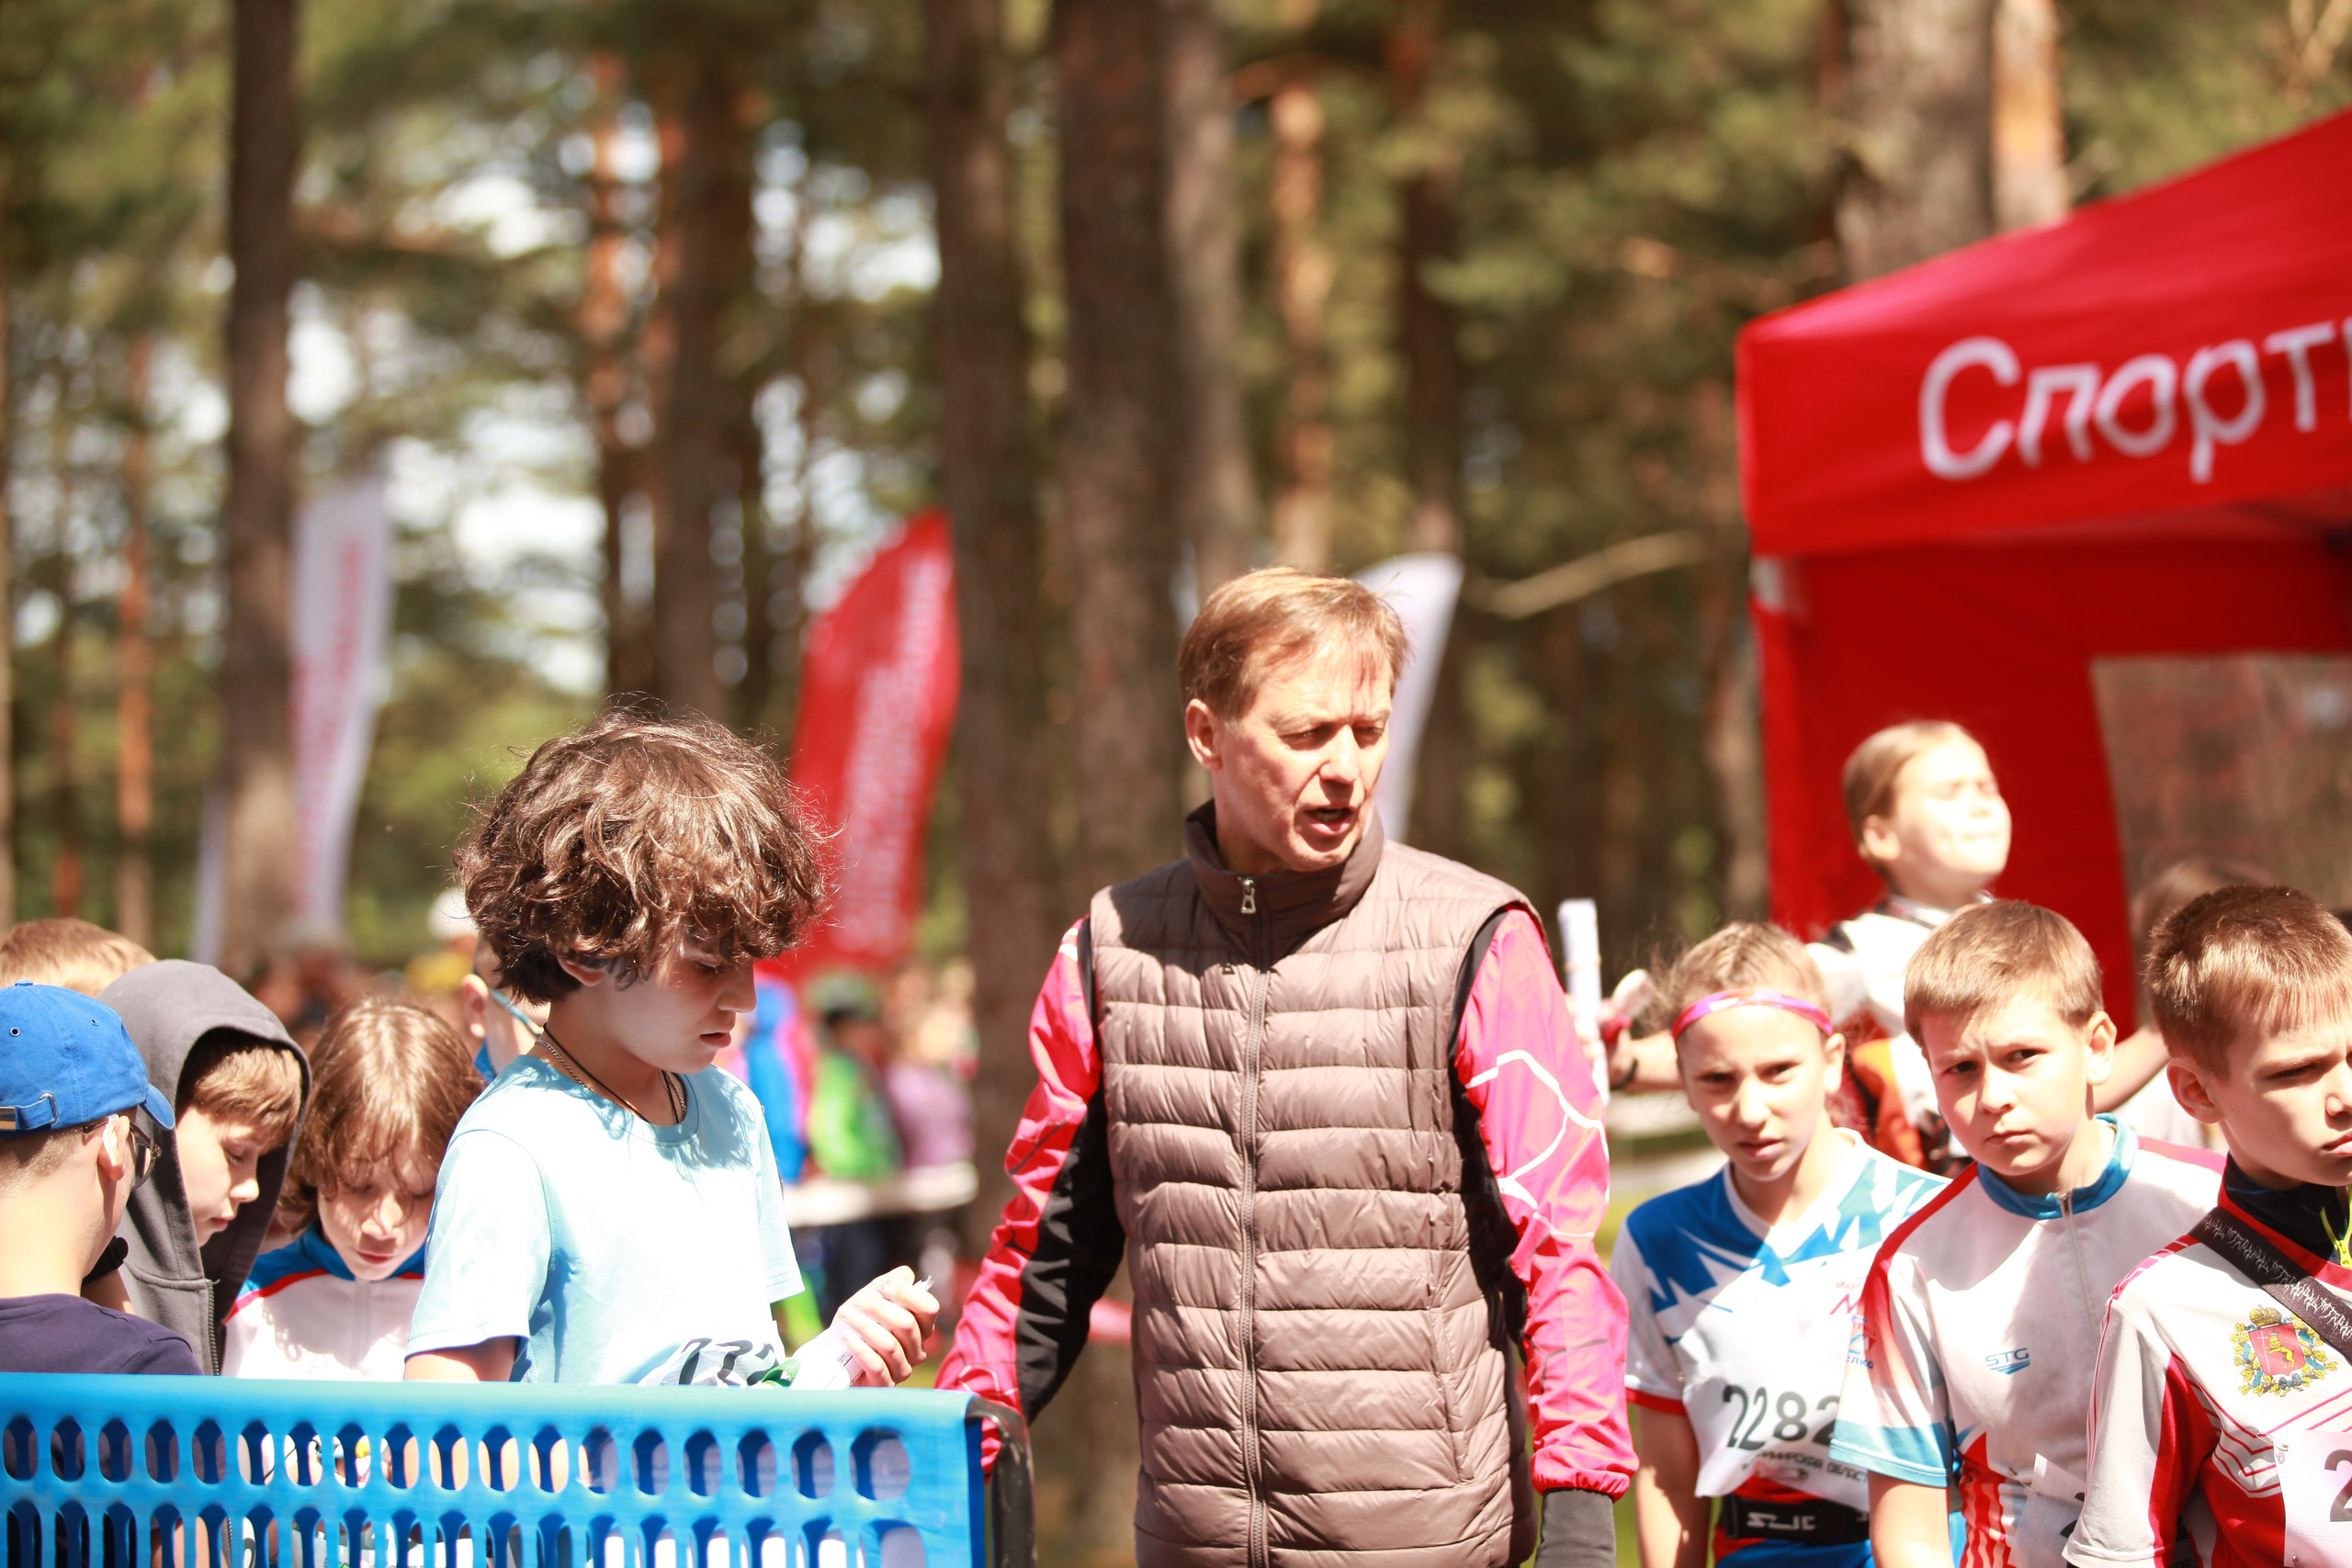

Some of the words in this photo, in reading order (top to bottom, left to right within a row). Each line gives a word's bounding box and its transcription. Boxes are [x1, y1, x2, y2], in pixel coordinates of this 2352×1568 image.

[1918, 316, 2352, 485] Спорт
[1985, 1347, 2030, 1367] STG
[1724, 1385, 1840, 1450] 2282
